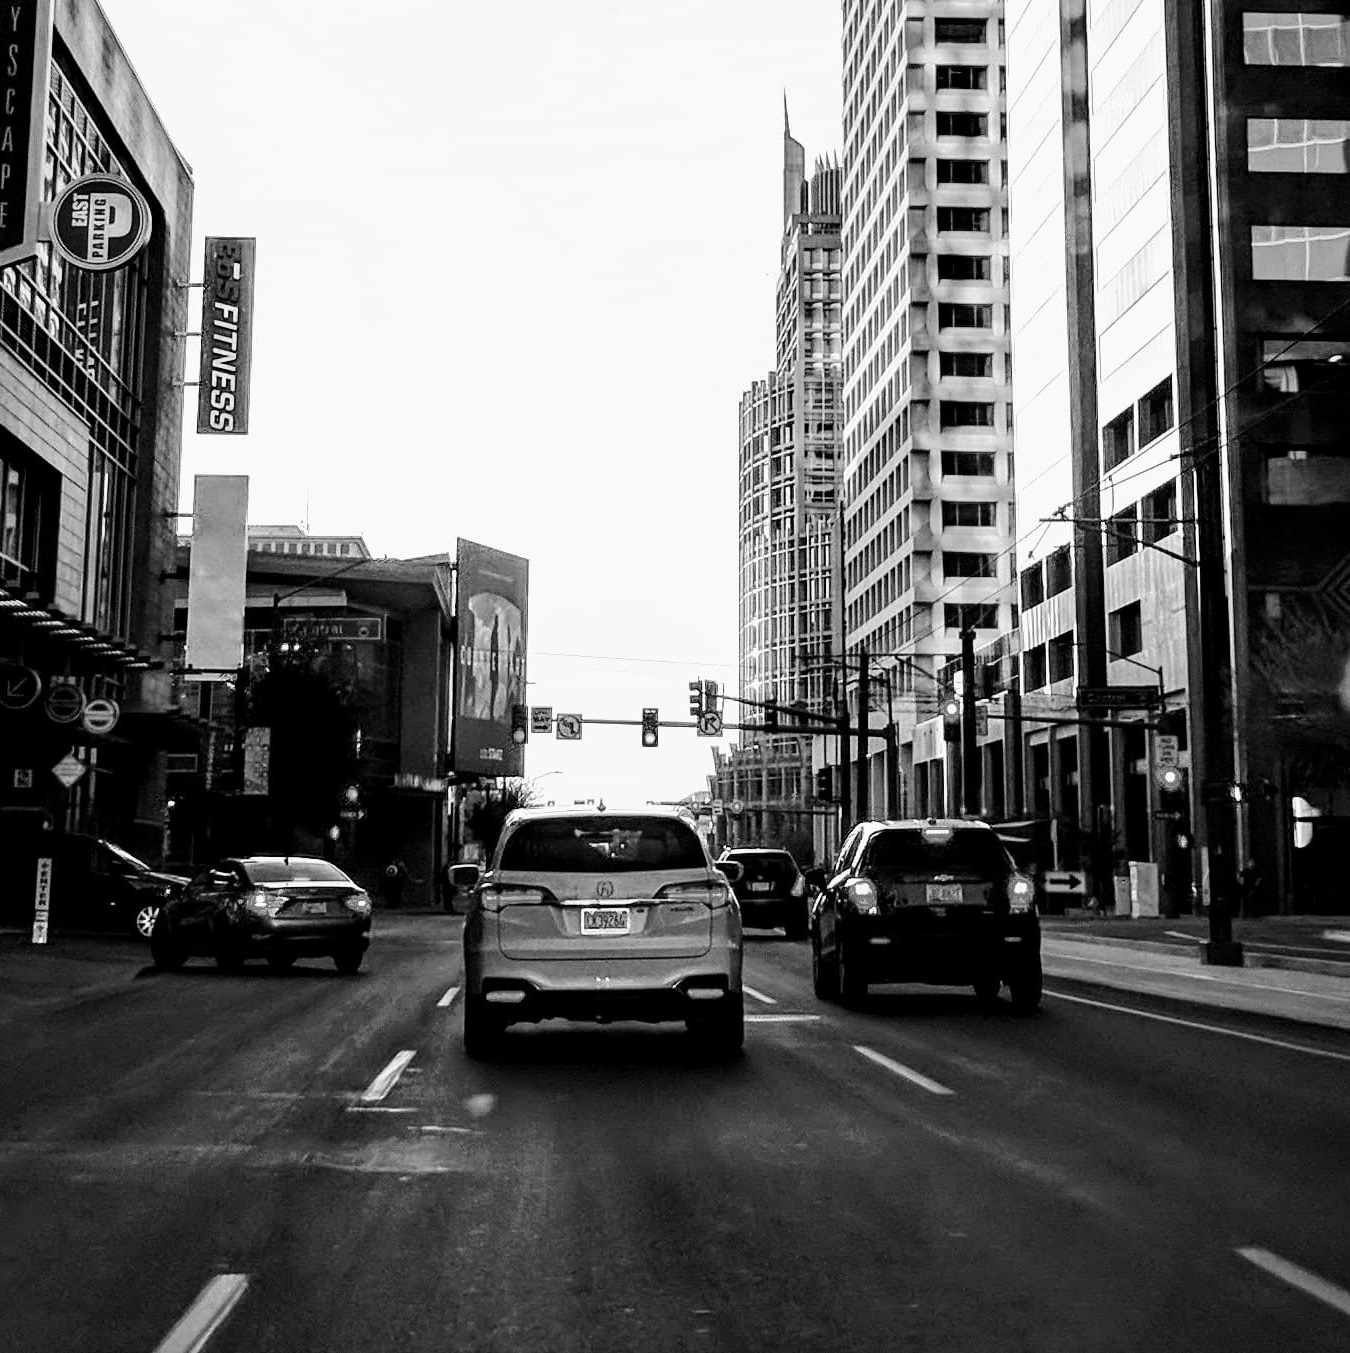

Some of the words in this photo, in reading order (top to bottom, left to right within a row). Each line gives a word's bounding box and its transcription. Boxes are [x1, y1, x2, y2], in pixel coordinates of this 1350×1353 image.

[71, 193, 89, 227] EAST
[91, 198, 107, 258] PARKING
[209, 301, 239, 433] FITNESS
